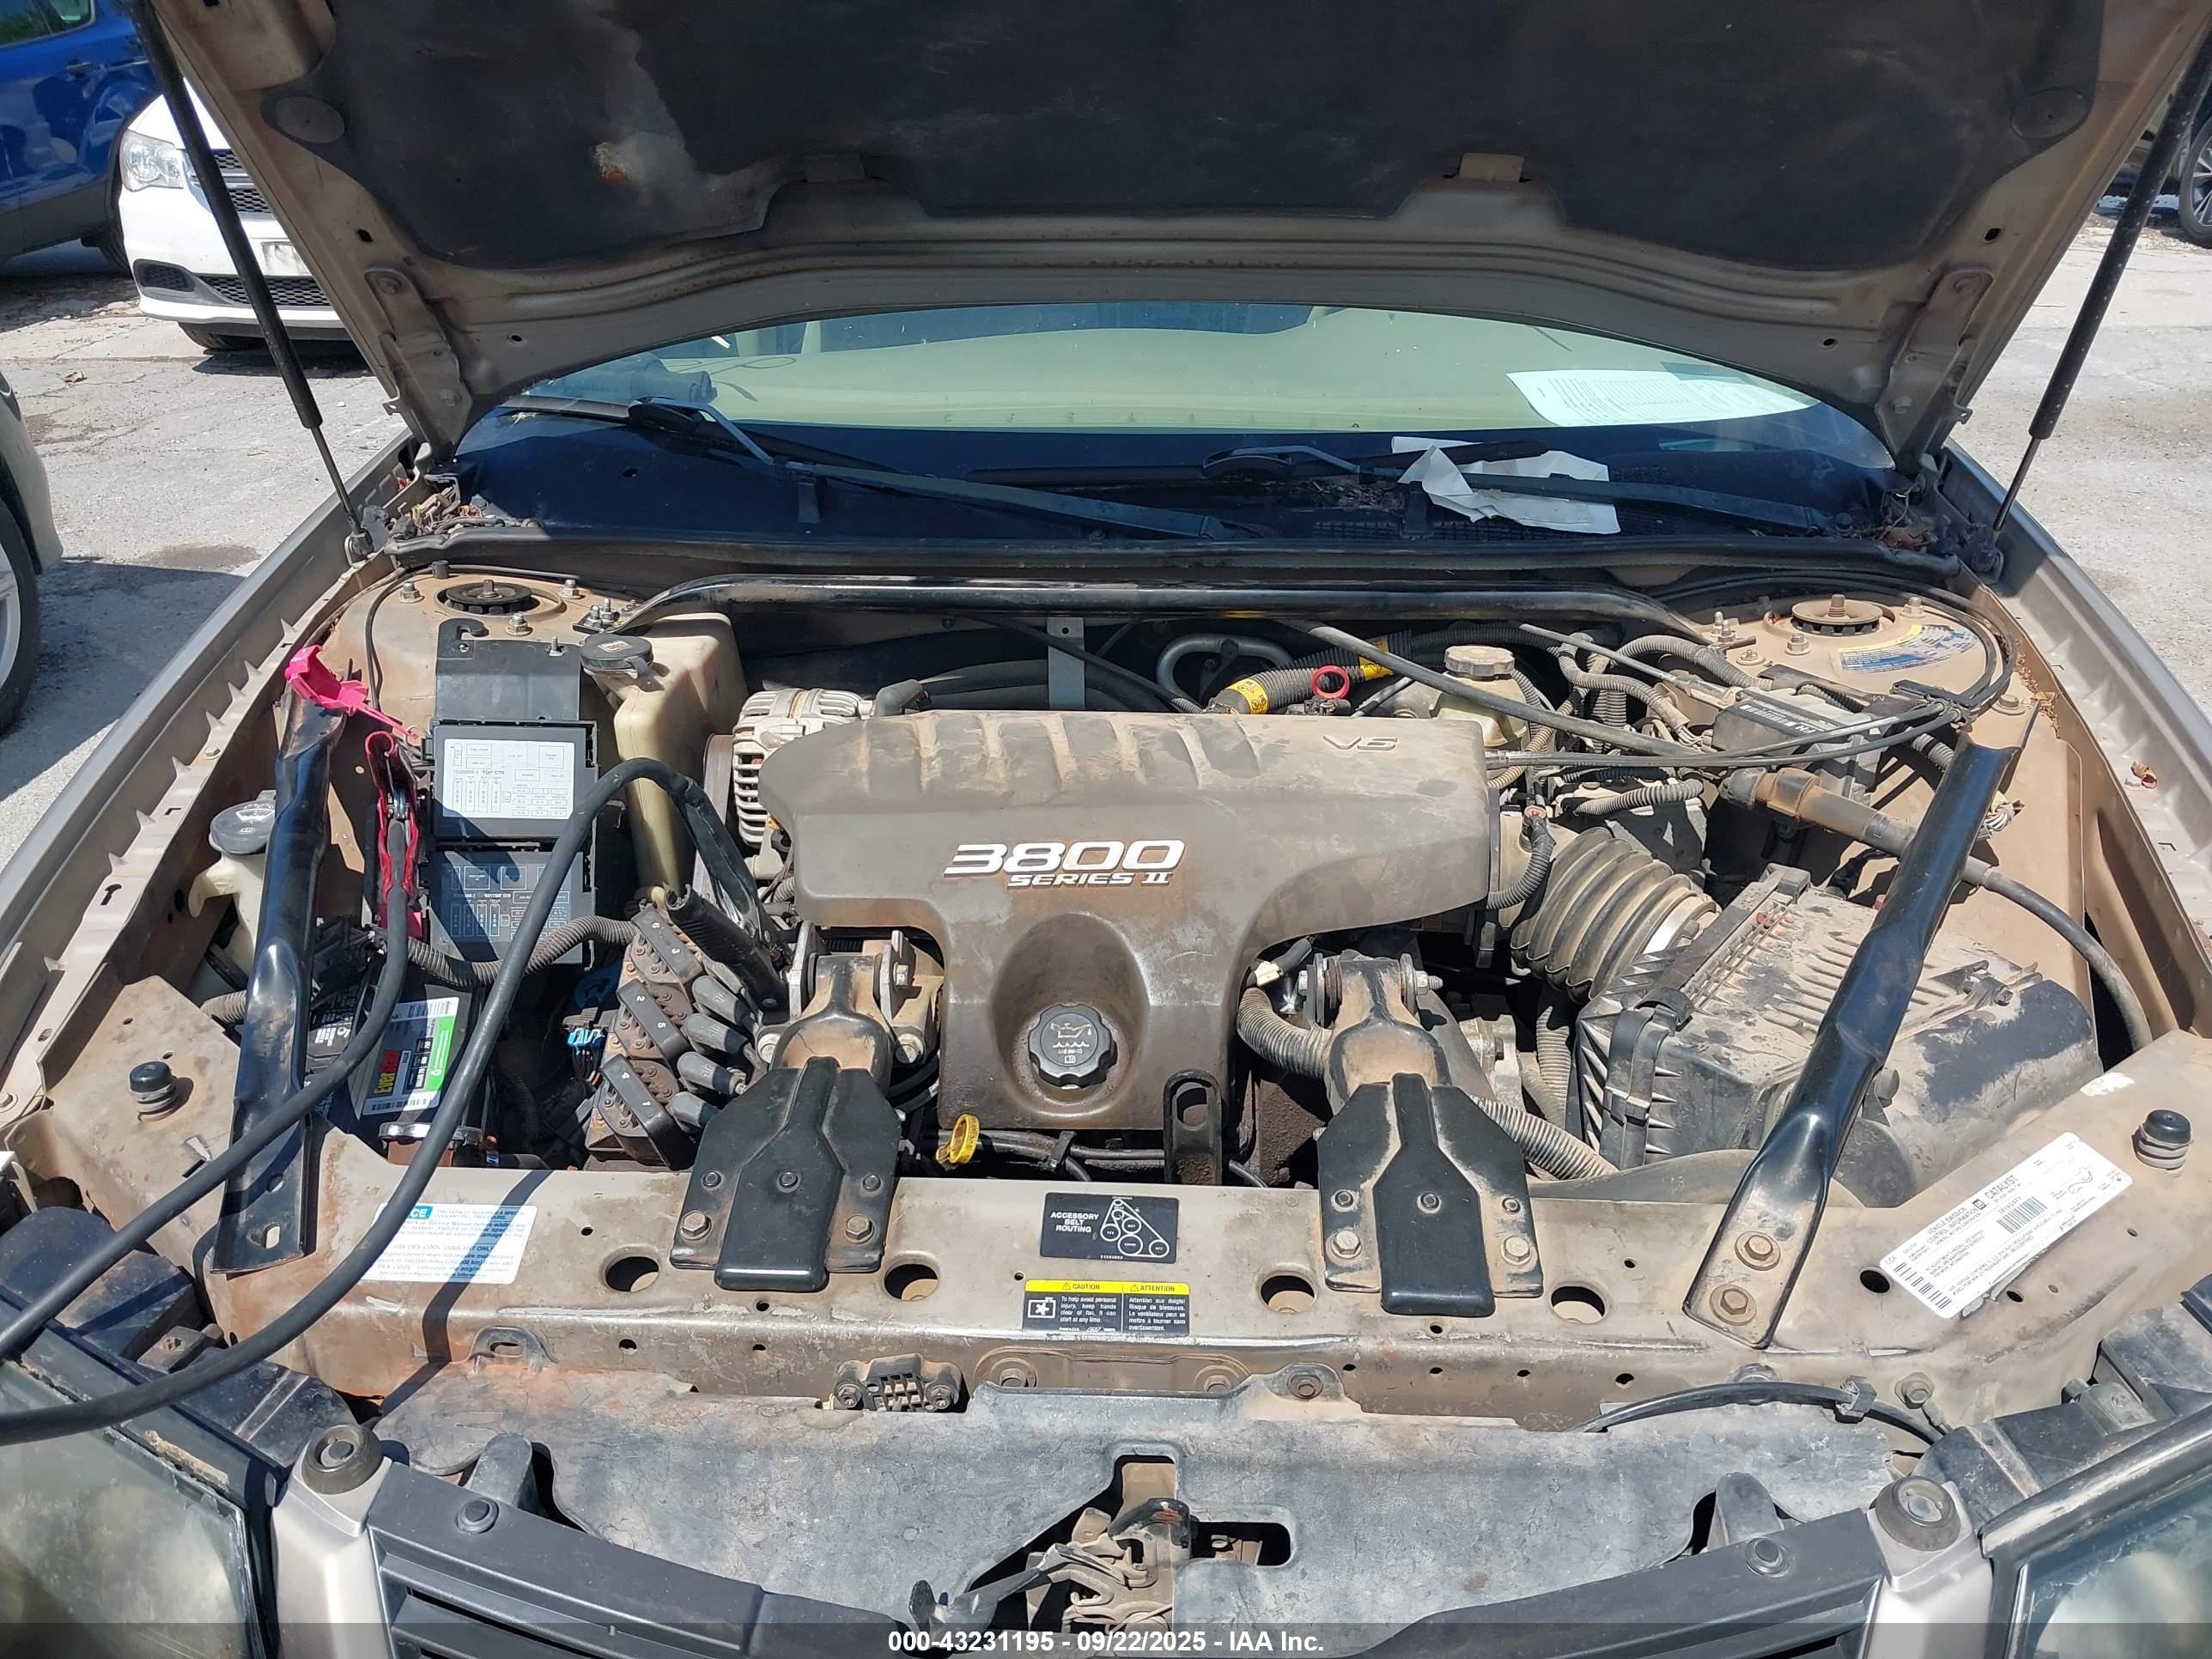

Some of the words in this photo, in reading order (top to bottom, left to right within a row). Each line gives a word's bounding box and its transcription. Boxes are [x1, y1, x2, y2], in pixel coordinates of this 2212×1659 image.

[1322, 734, 1400, 751] V6
[944, 840, 1184, 876] 3800
[1007, 872, 1134, 888] SERIES
[1140, 872, 1173, 884] II
[1984, 1173, 2019, 1200] CATALYST
